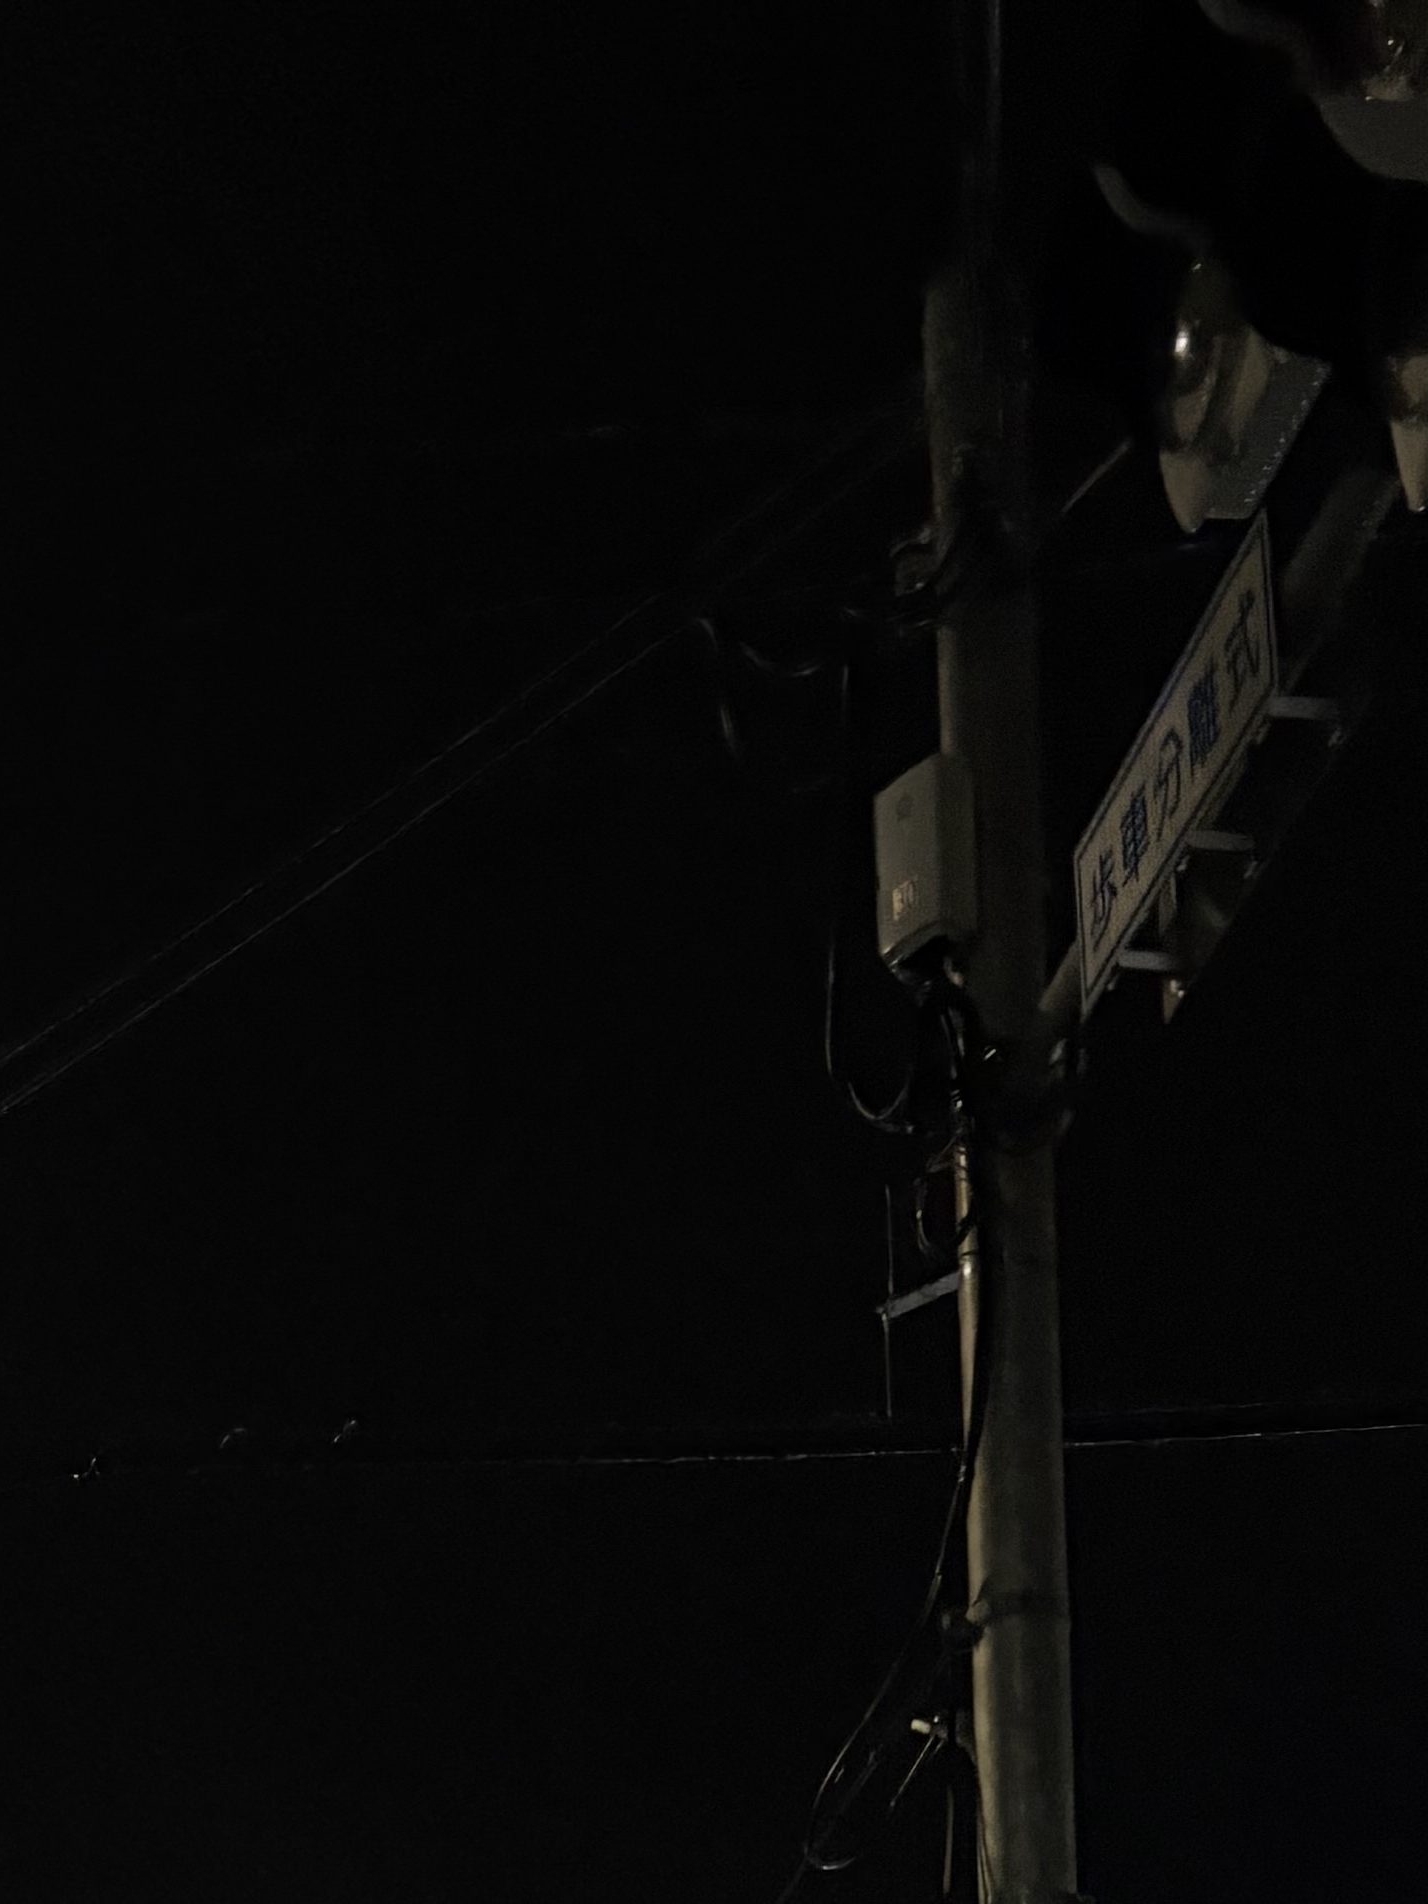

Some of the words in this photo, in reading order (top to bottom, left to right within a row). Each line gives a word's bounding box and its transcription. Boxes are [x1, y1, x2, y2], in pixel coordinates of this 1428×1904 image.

[1090, 589, 1260, 950] 歩車分離式
